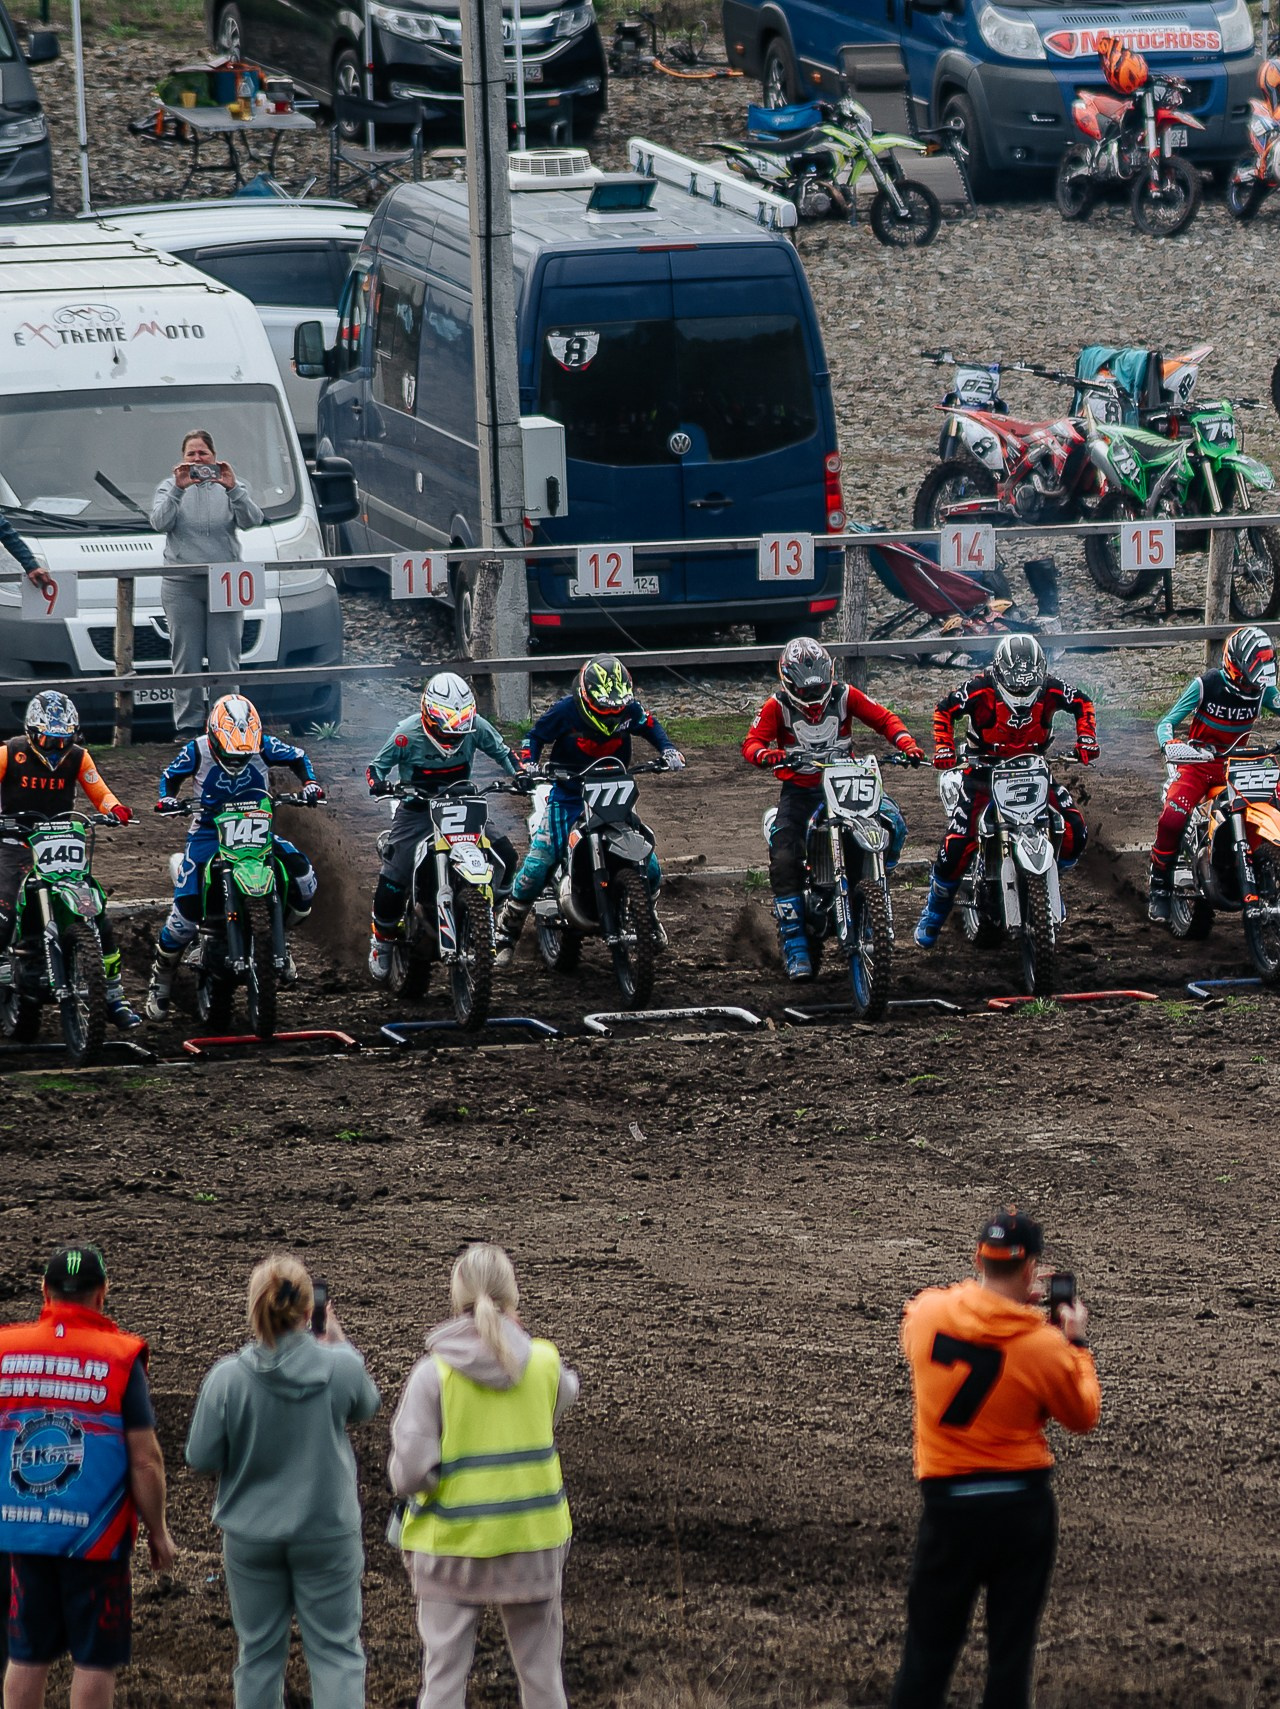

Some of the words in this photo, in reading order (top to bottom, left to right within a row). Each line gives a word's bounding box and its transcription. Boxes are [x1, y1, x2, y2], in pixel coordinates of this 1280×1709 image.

[961, 379, 994, 396] 82
[769, 540, 803, 576] 13
[952, 531, 984, 567] 14
[1131, 529, 1164, 565] 15
[402, 558, 432, 594] 11
[588, 552, 622, 589] 12
[41, 578, 59, 616] 9
[220, 570, 255, 607] 10
[1206, 702, 1256, 721] SEVEN
[21, 775, 66, 790] SEVEN
[584, 780, 635, 808] 777
[834, 779, 875, 803] 715
[1234, 769, 1280, 791] 222
[1005, 782, 1042, 807] 3
[223, 818, 270, 846] 142
[440, 804, 468, 834] 2
[450, 835, 477, 843] MOTUL
[38, 845, 85, 866] 440
[930, 1331, 1007, 1432] 7
